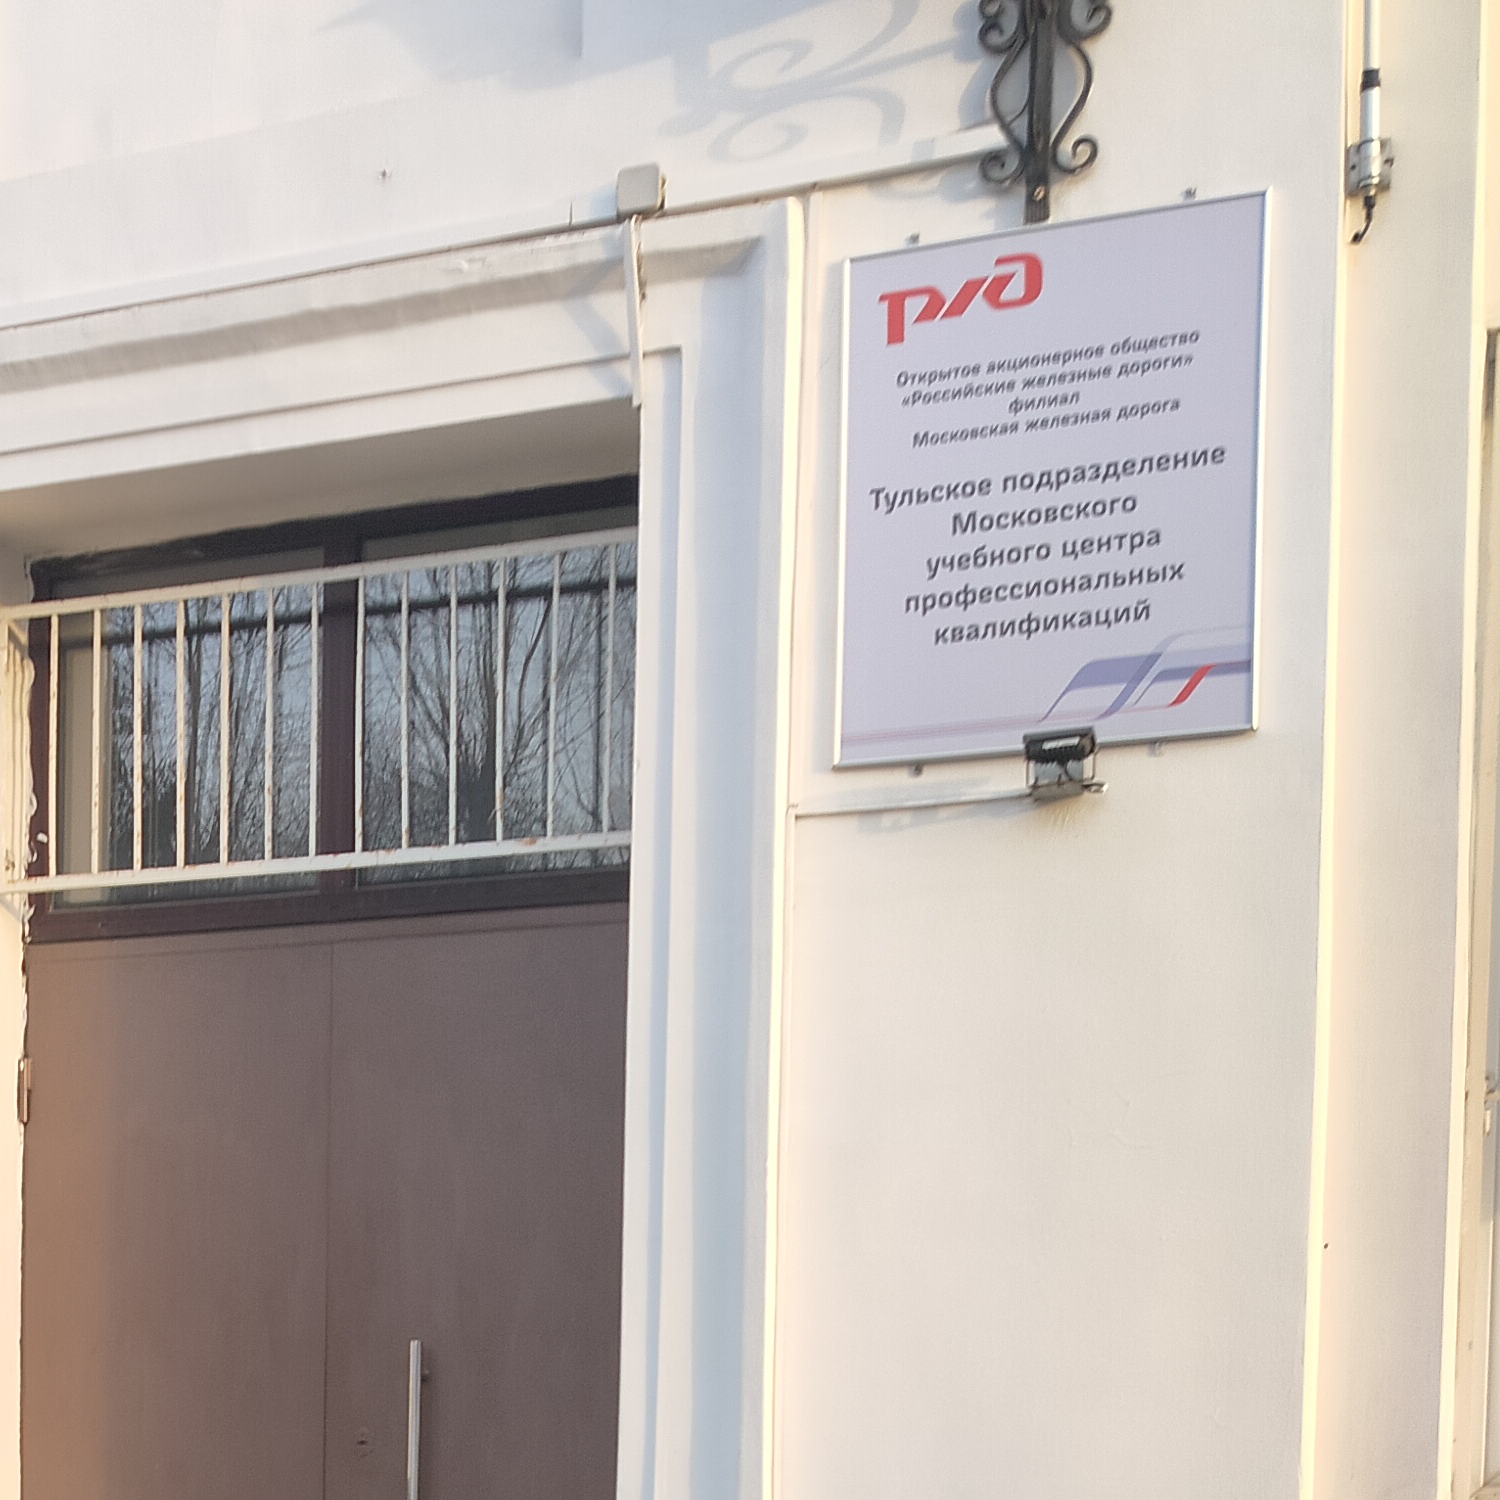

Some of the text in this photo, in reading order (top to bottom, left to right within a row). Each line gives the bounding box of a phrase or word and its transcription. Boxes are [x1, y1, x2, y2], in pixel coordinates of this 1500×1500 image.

[896, 330, 1200, 388] Открытое акционерное общество
[901, 354, 1194, 407] «Российские железные дороги»
[912, 397, 1180, 448] Московская железная дорога
[1008, 390, 1080, 416] филиал
[869, 444, 1227, 514] Тульское подразделение
[951, 494, 1138, 537] Московского
[926, 528, 1161, 580] учебного центра
[904, 561, 1185, 617] профессиональных
[934, 598, 1151, 646] квалификаций
